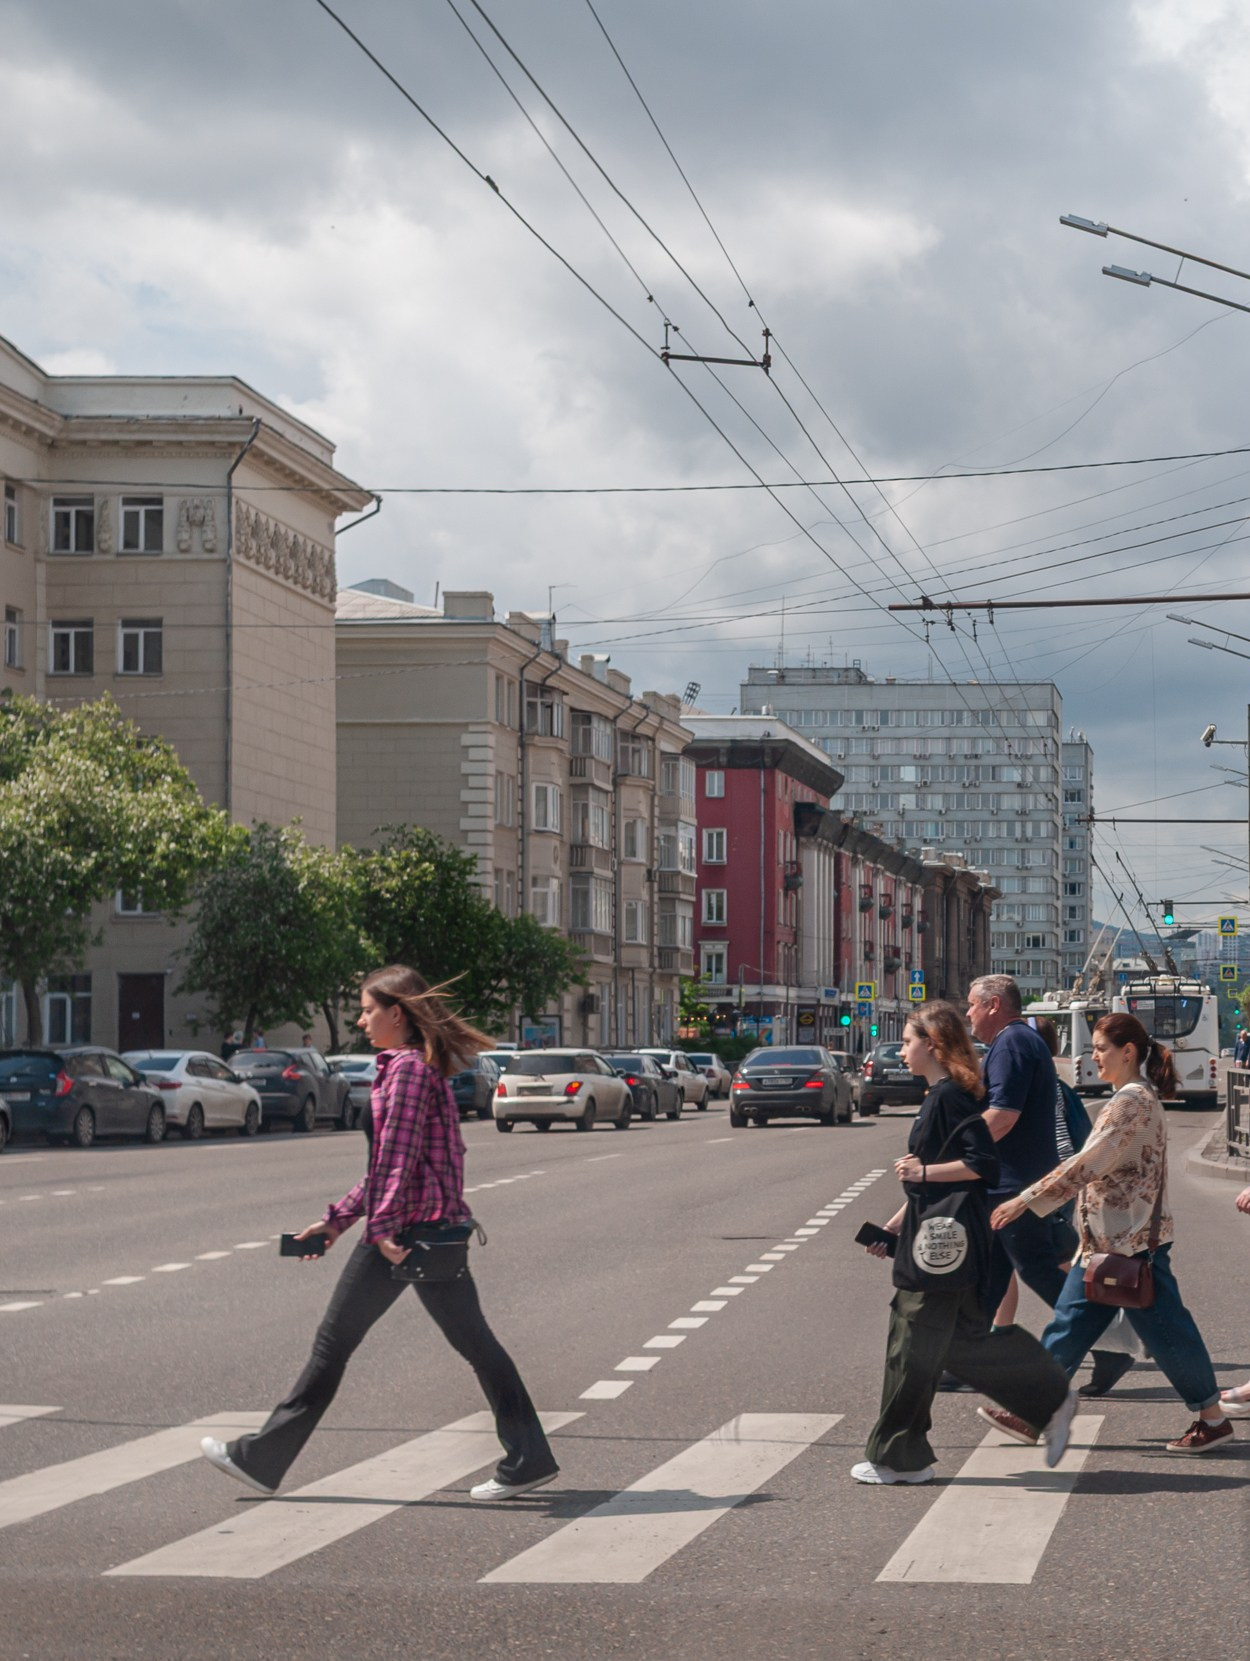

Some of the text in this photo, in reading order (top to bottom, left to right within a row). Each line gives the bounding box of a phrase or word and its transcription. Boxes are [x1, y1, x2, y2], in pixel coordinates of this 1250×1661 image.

[1180, 999, 1188, 1008] 7
[928, 1222, 953, 1231] WEAR
[930, 1230, 958, 1241] SMILE
[926, 1240, 965, 1251] NOTHING
[930, 1251, 952, 1261] ELSE
